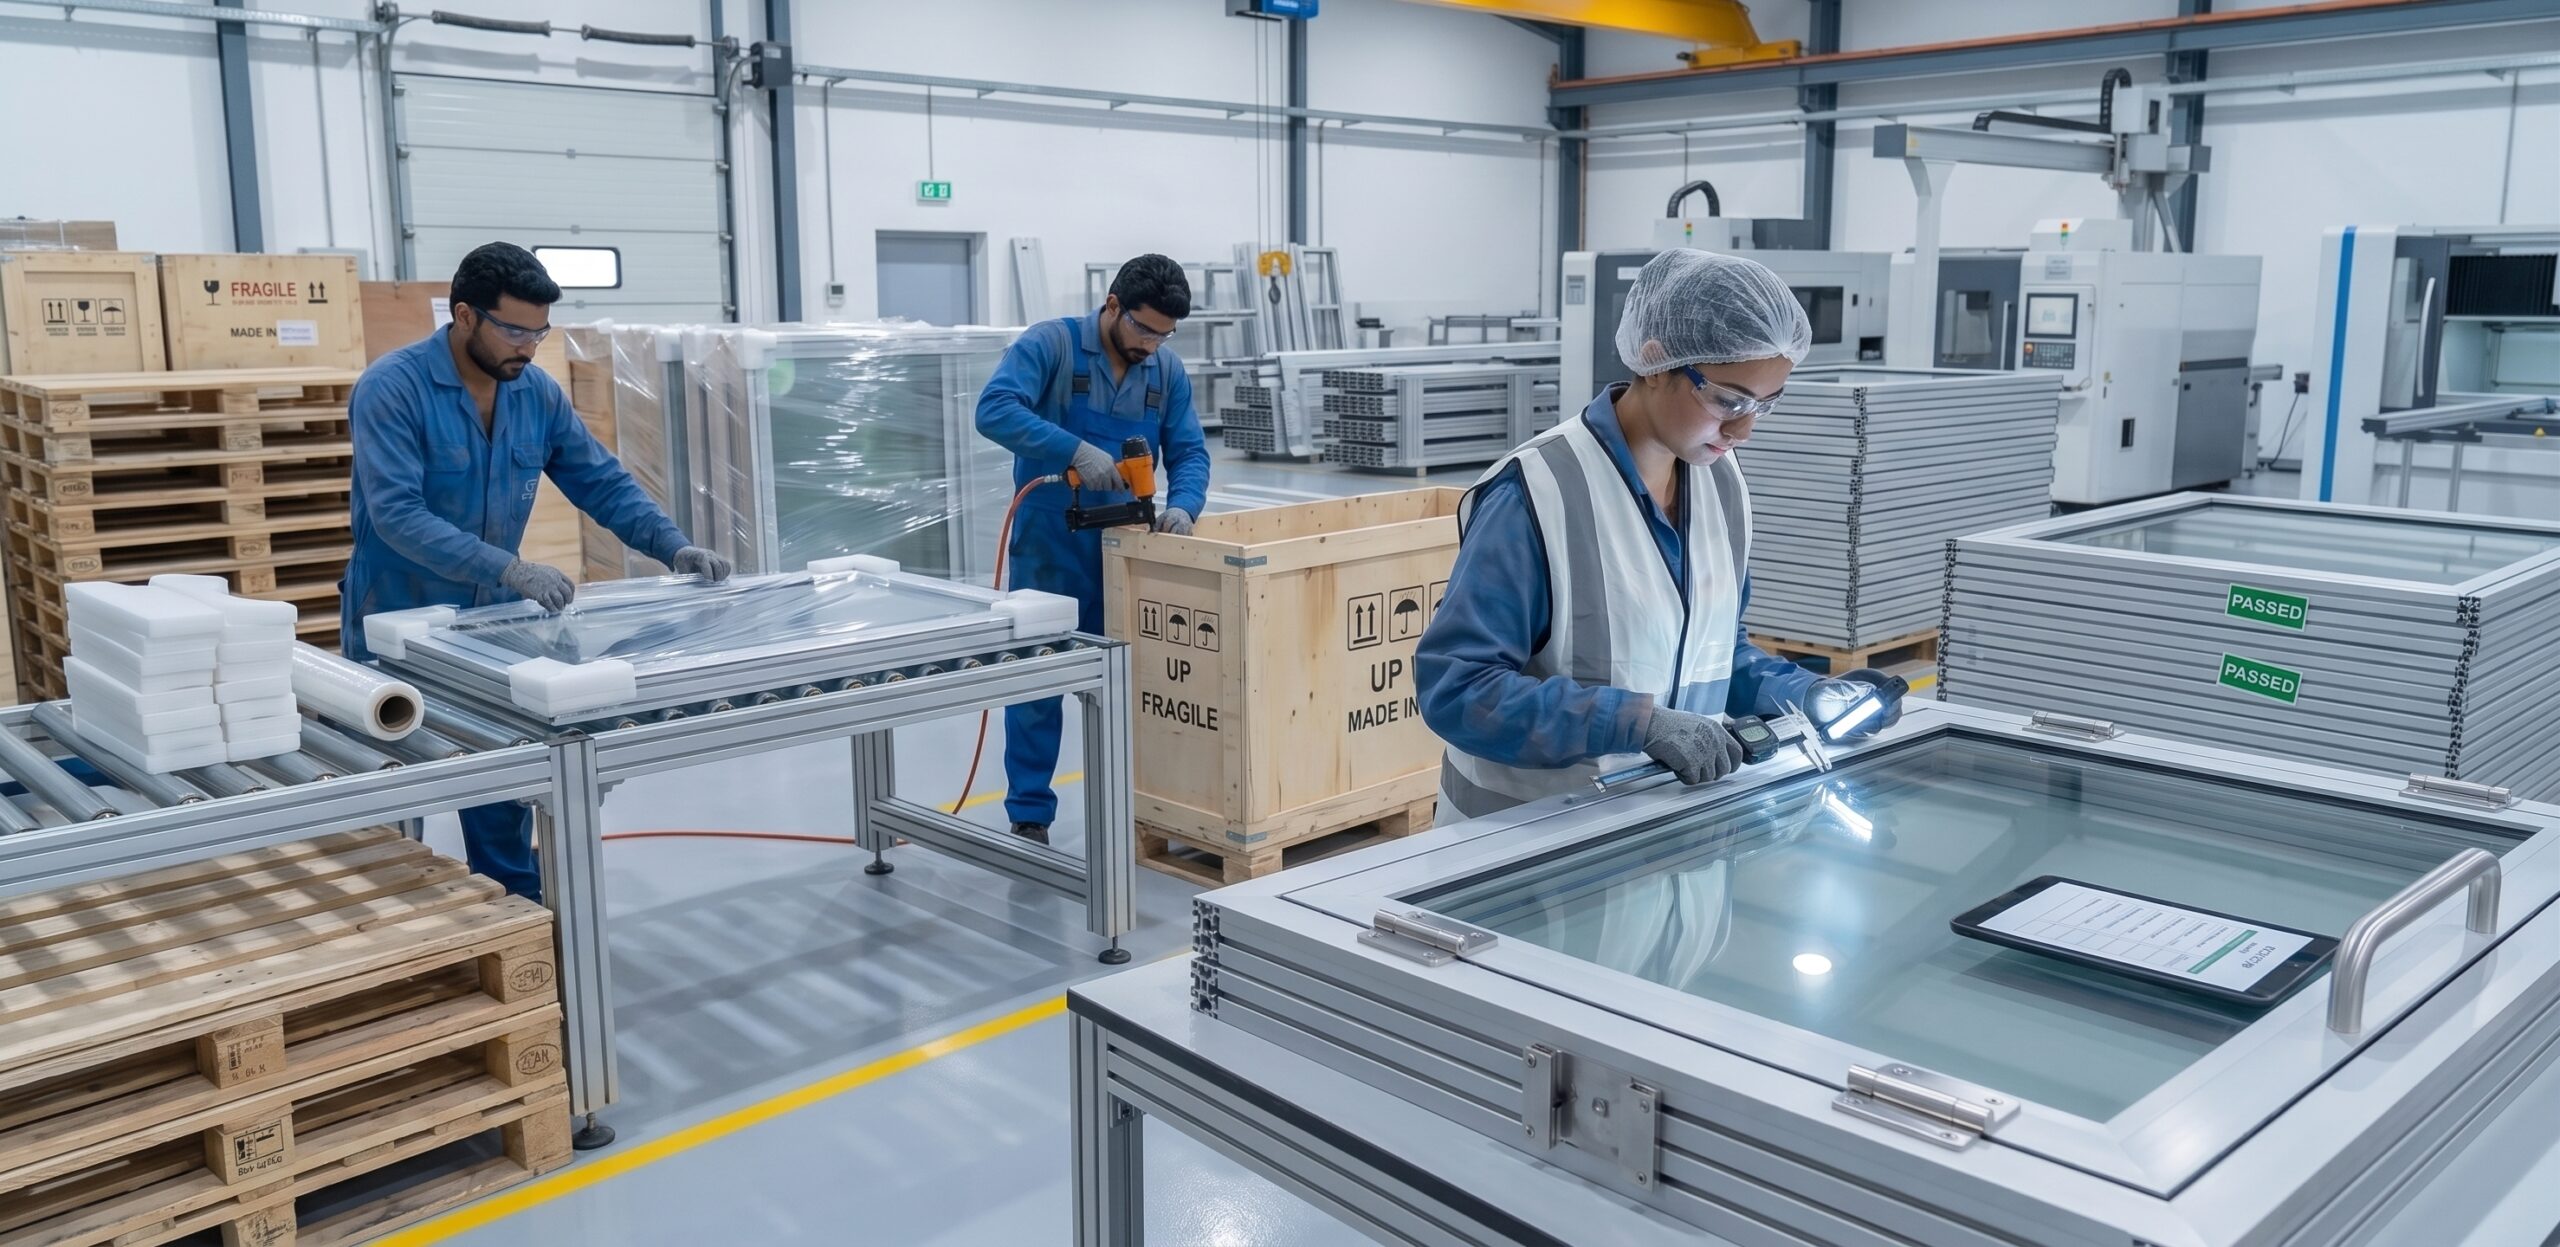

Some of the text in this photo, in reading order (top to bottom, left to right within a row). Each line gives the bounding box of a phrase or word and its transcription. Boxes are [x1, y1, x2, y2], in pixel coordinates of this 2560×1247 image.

[231, 282, 297, 297] FRAGILE
[230, 327, 263, 338] MADE
[266, 327, 277, 338] IN
[2231, 593, 2303, 620] PASSED
[1166, 657, 1191, 683] UP
[1371, 658, 1403, 692] UP
[2224, 663, 2295, 693] PASSED
[1142, 691, 1218, 731] FRAGILE
[1348, 696, 1420, 733] MADE IN
